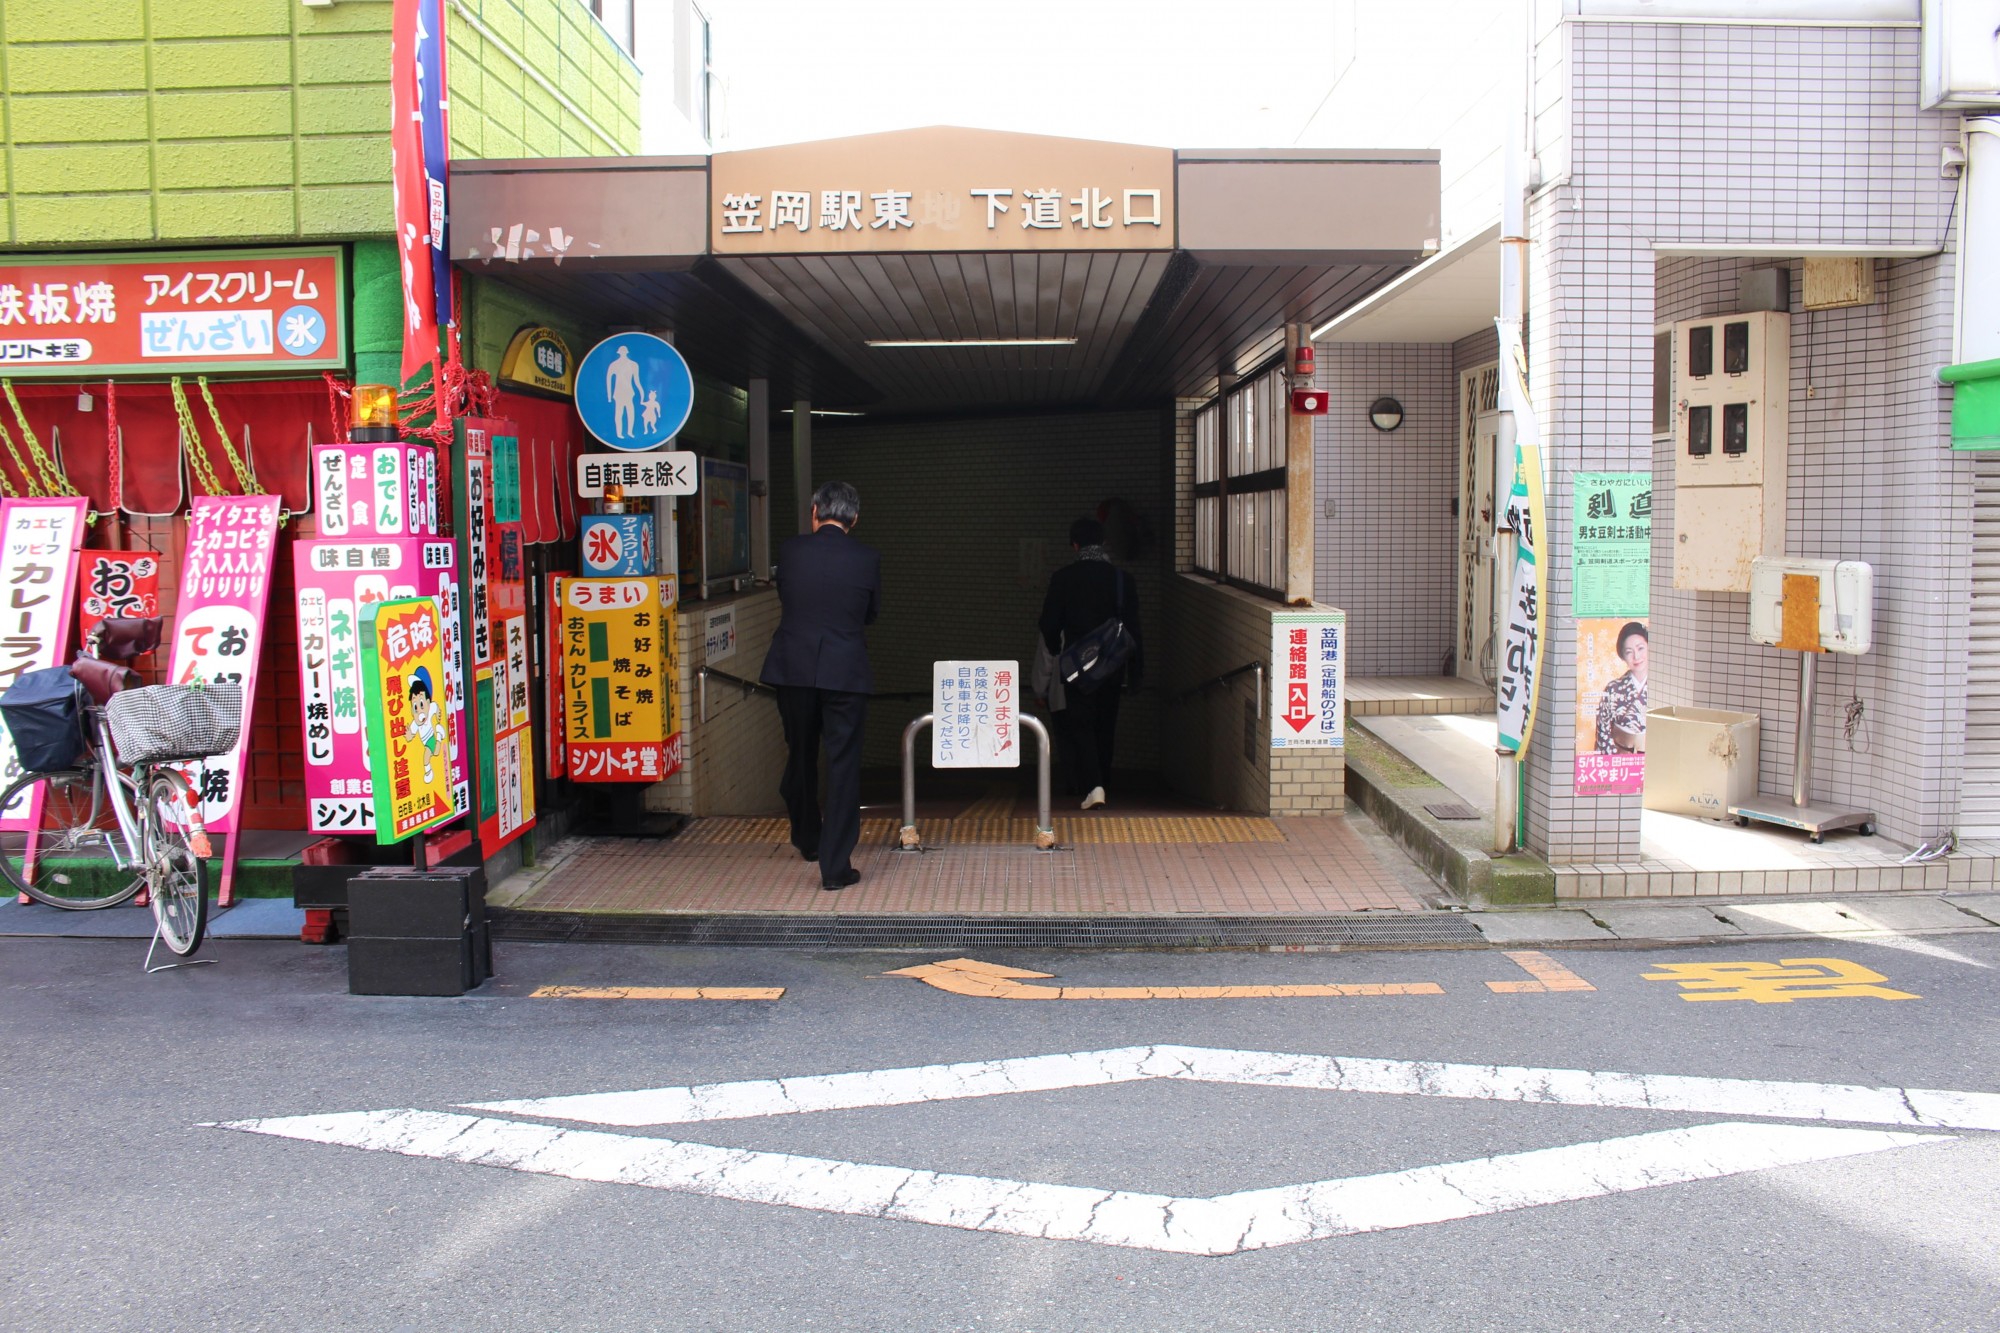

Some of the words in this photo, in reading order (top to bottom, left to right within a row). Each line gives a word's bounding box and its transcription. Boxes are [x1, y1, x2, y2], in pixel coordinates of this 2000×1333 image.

[142, 268, 319, 305] アイスクリーム
[144, 314, 270, 351] ぜんざい
[285, 314, 317, 348] 氷
[322, 455, 344, 529] ぜんざい
[350, 454, 369, 526] 定食
[376, 454, 398, 528] おでん
[408, 455, 418, 528] ぜんざい
[426, 457, 436, 529] おでん
[585, 461, 687, 487] 自転車を除く
[12, 518, 31, 556] カツ
[29, 518, 48, 555] エビ
[46, 516, 66, 555] ビーフ
[186, 504, 211, 599] チーズ入り
[202, 505, 226, 599] イカ入り
[218, 504, 242, 599] タコ入り
[234, 505, 258, 599] エビ入り
[250, 504, 273, 599] もち入り
[319, 547, 391, 568] 味自慢
[426, 546, 450, 566] 味自慢
[471, 466, 489, 659] お好み焼き
[586, 528, 620, 563] 氷
[622, 516, 640, 575] アイスクリーム
[642, 528, 650, 562] 氷
[300, 597, 309, 627] カツ
[308, 597, 317, 627] エビ
[315, 596, 325, 627] ビーフ
[574, 585, 642, 604] うまい
[660, 584, 675, 601] うまい
[330, 609, 357, 718] ネギ焼
[386, 613, 434, 662] 危険
[567, 616, 586, 657] おでん
[632, 611, 654, 704] お好み焼
[1289, 628, 1307, 680] 連絡路
[440, 585, 457, 746] お好み焼
[510, 625, 527, 712] ネギ焼
[612, 657, 633, 727] 焼そば
[303, 633, 330, 760] カレー・焼めし
[570, 663, 590, 740] カレーライス
[940, 678, 954, 761] 押してください
[957, 667, 971, 750] 自転車は降りて
[974, 666, 989, 725] 危険なので
[1291, 687, 1307, 720] 入口
[386, 674, 412, 801] 飛び出し注意
[571, 745, 659, 777] シントキ堂
[662, 731, 683, 776] シントキ堂
[1578, 756, 1604, 768] 5/15
[500, 766, 508, 833] カレーライス
[1689, 796, 1719, 805] ALVA
